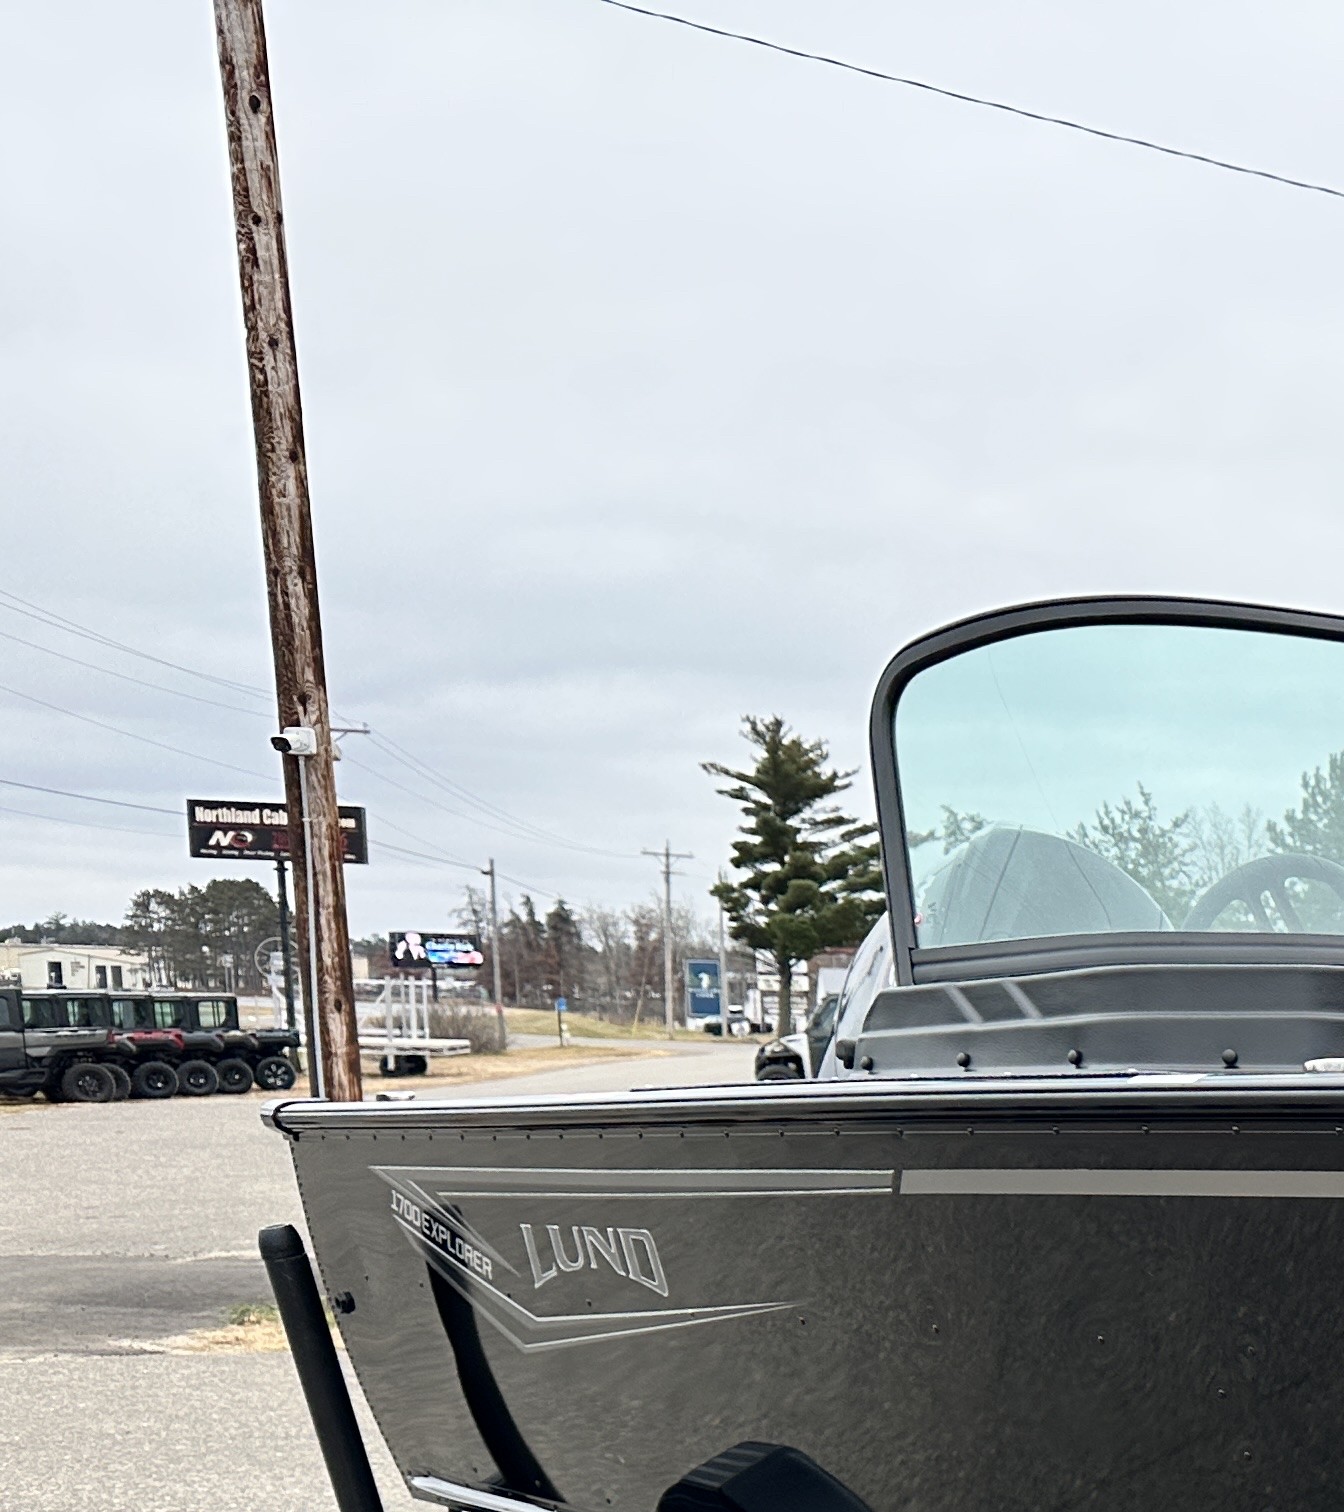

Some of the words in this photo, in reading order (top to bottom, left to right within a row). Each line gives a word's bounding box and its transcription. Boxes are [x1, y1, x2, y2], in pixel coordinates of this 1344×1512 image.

[194, 806, 261, 825] Northland
[391, 1190, 421, 1227] 1700
[421, 1212, 493, 1280] EXPLORER
[519, 1223, 669, 1297] LUND
